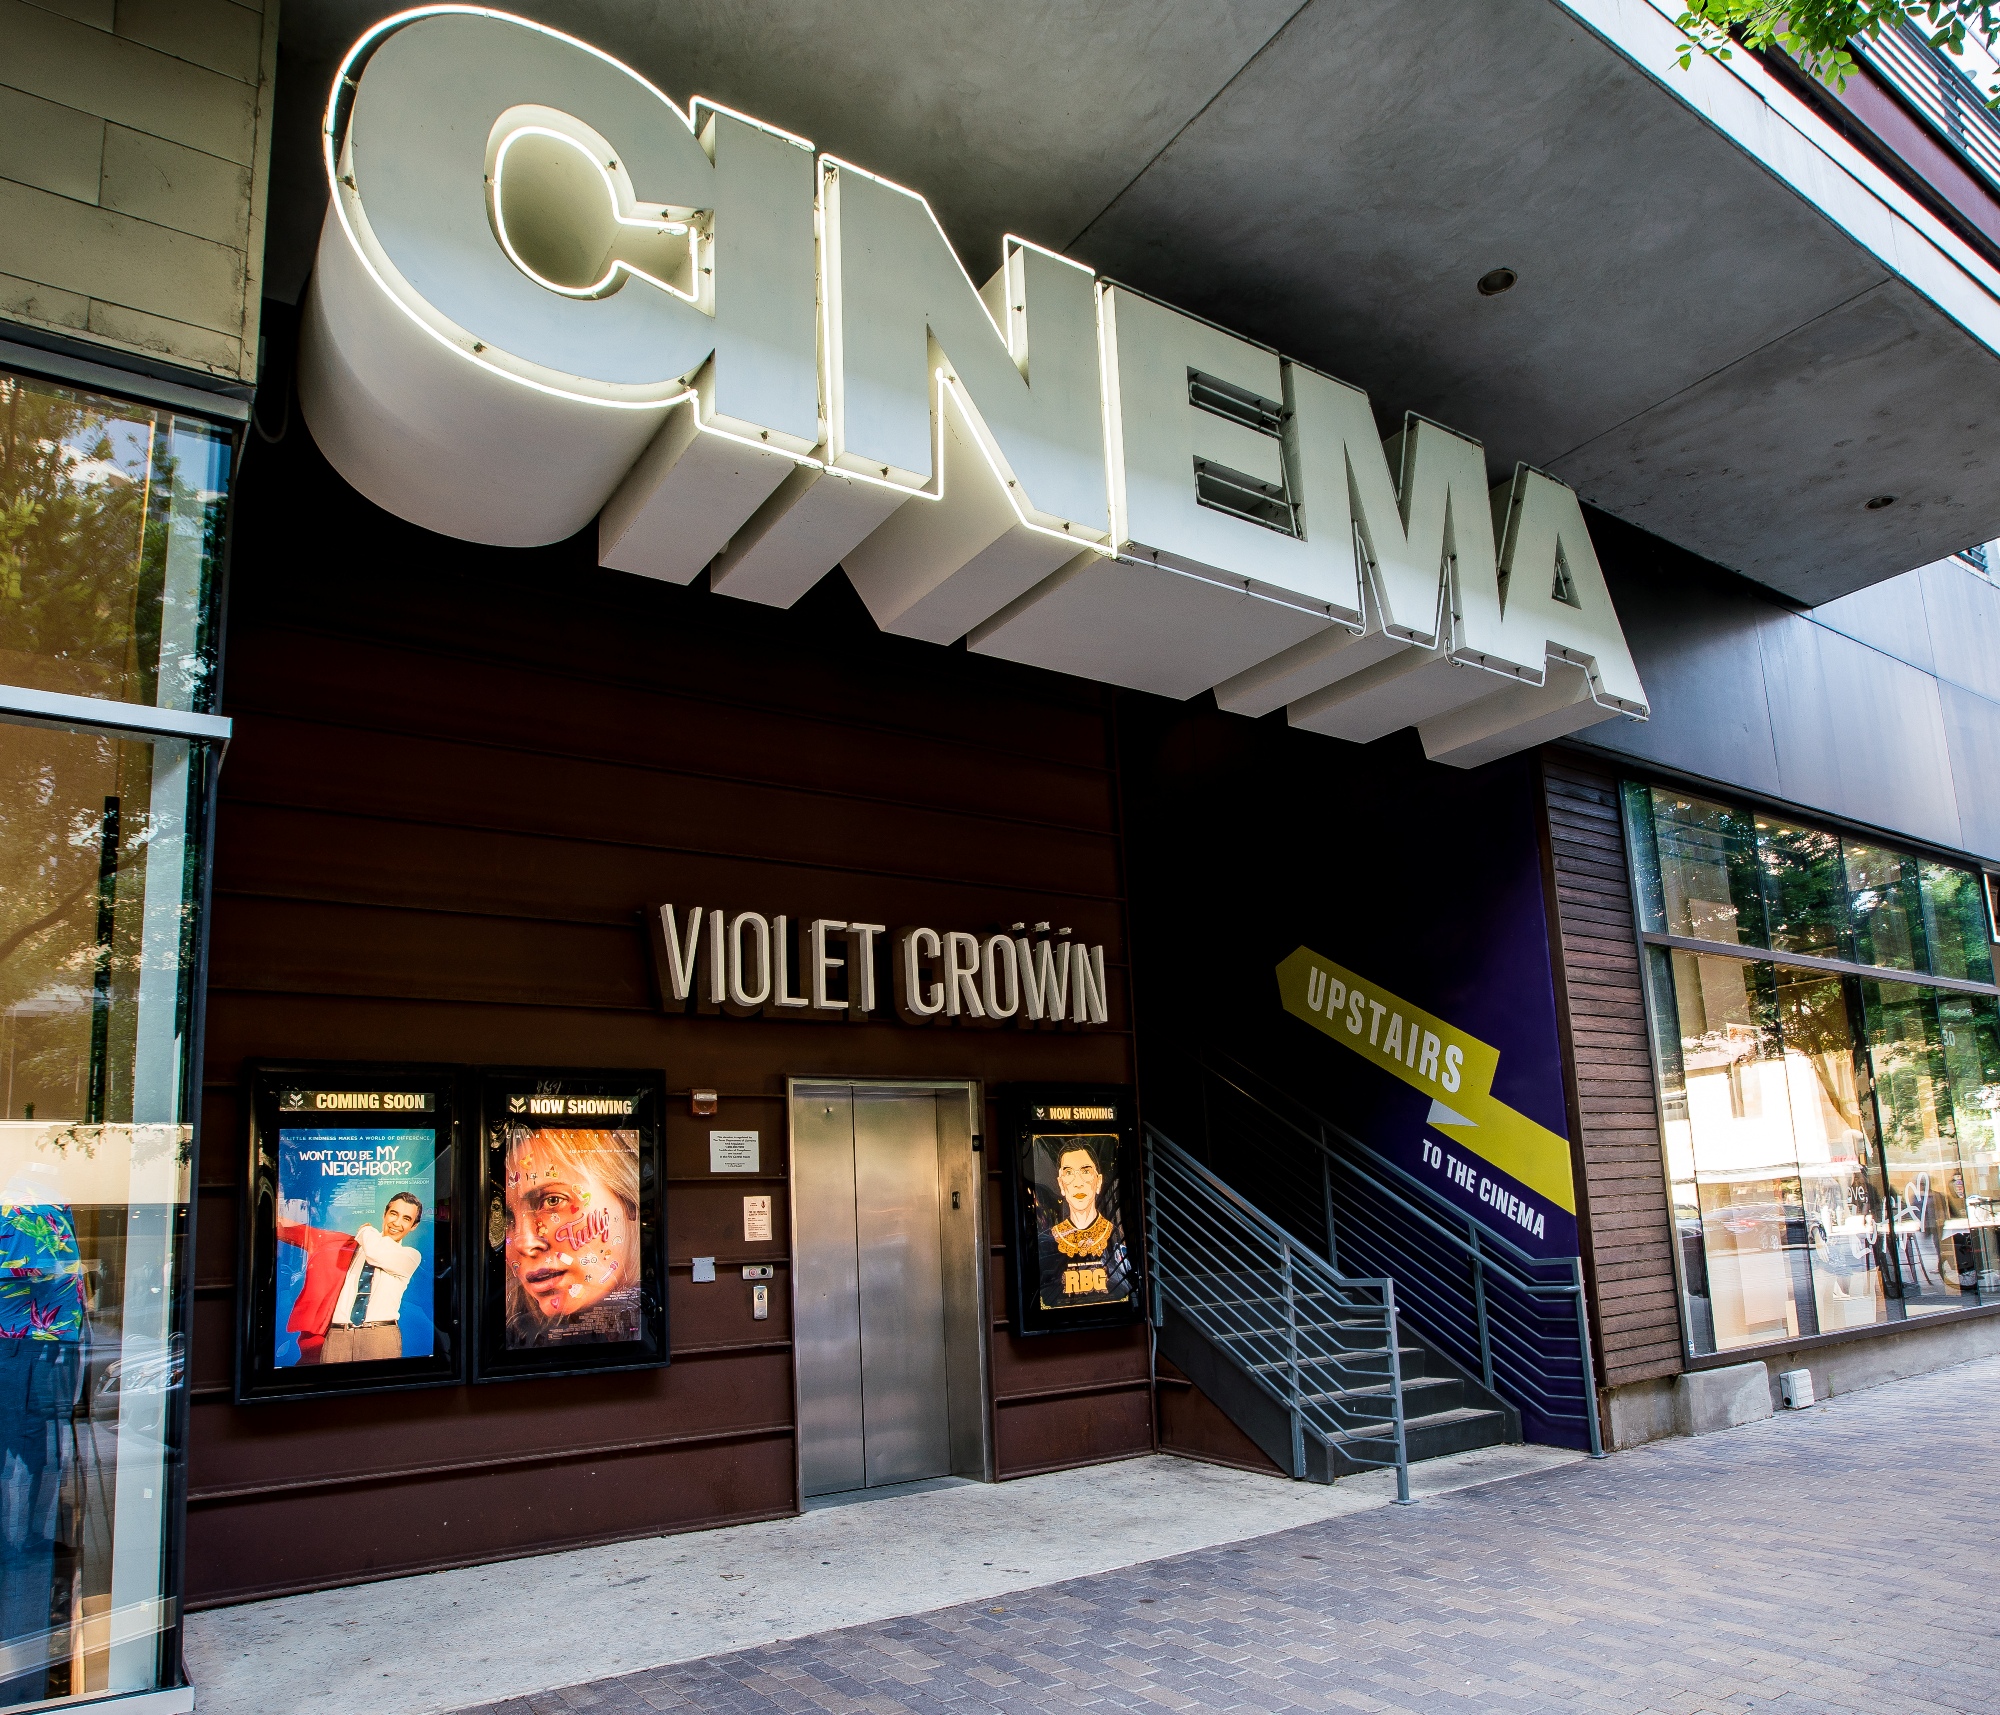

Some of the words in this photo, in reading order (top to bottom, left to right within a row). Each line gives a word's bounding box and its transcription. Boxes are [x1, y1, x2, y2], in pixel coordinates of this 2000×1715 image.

[322, 3, 1651, 722] CINEMA
[659, 903, 886, 1013] VIOLET
[1306, 965, 1465, 1094] UPSTAIRS
[315, 1093, 380, 1109] COMING
[383, 1094, 425, 1109] SOON
[530, 1099, 565, 1114] NOW
[567, 1100, 633, 1115] SHOWING
[1049, 1107, 1071, 1119] NOW
[1073, 1107, 1114, 1120] SHOWING
[298, 1150, 333, 1161] WON'T
[336, 1150, 357, 1161] YOU
[359, 1150, 374, 1161] BE
[376, 1145, 400, 1161] MY
[321, 1160, 412, 1177] NEIGHBOR?
[1422, 1138, 1442, 1170] TO
[1446, 1154, 1476, 1192] THE
[1479, 1177, 1546, 1240] CINEMA
[555, 1207, 610, 1251] Tully
[1063, 1268, 1108, 1294] RBG
